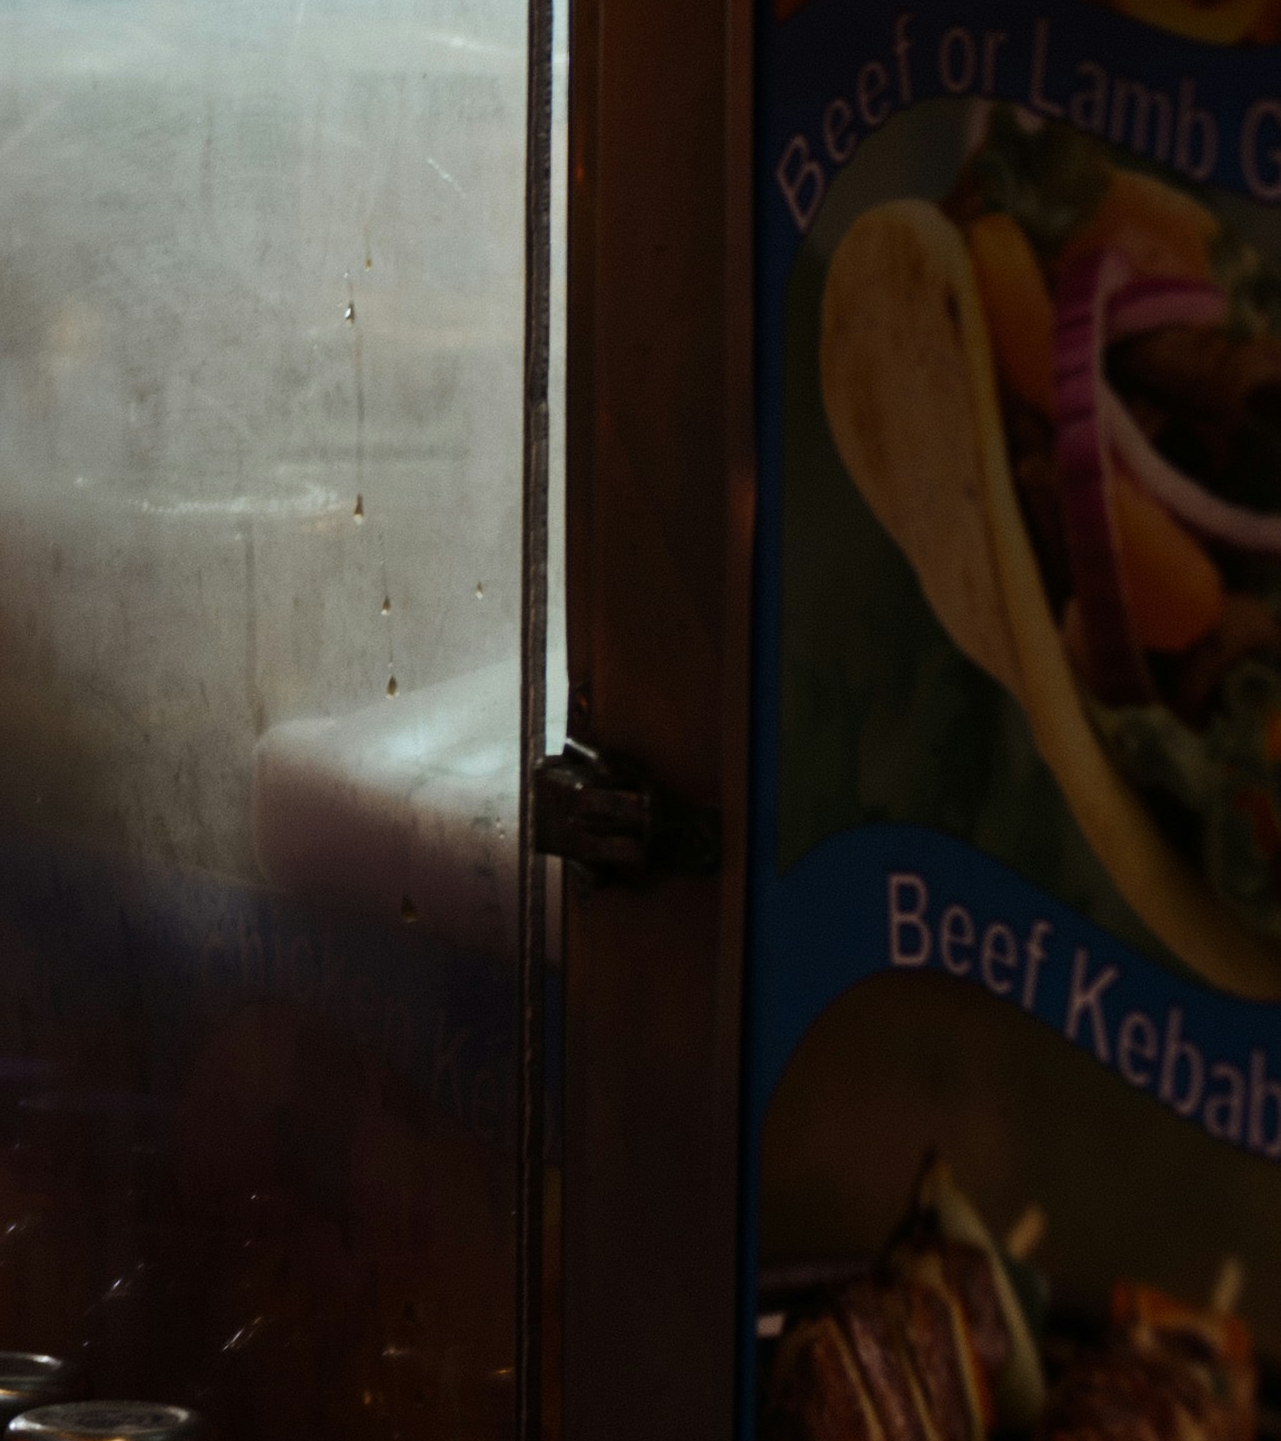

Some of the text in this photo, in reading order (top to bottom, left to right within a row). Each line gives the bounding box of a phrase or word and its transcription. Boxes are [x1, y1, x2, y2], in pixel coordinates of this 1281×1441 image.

[775, 13, 915, 233] Beef
[937, 25, 1007, 95] or
[1029, 18, 1220, 181] Lamb
[886, 872, 1281, 1161] Beef Kebab
